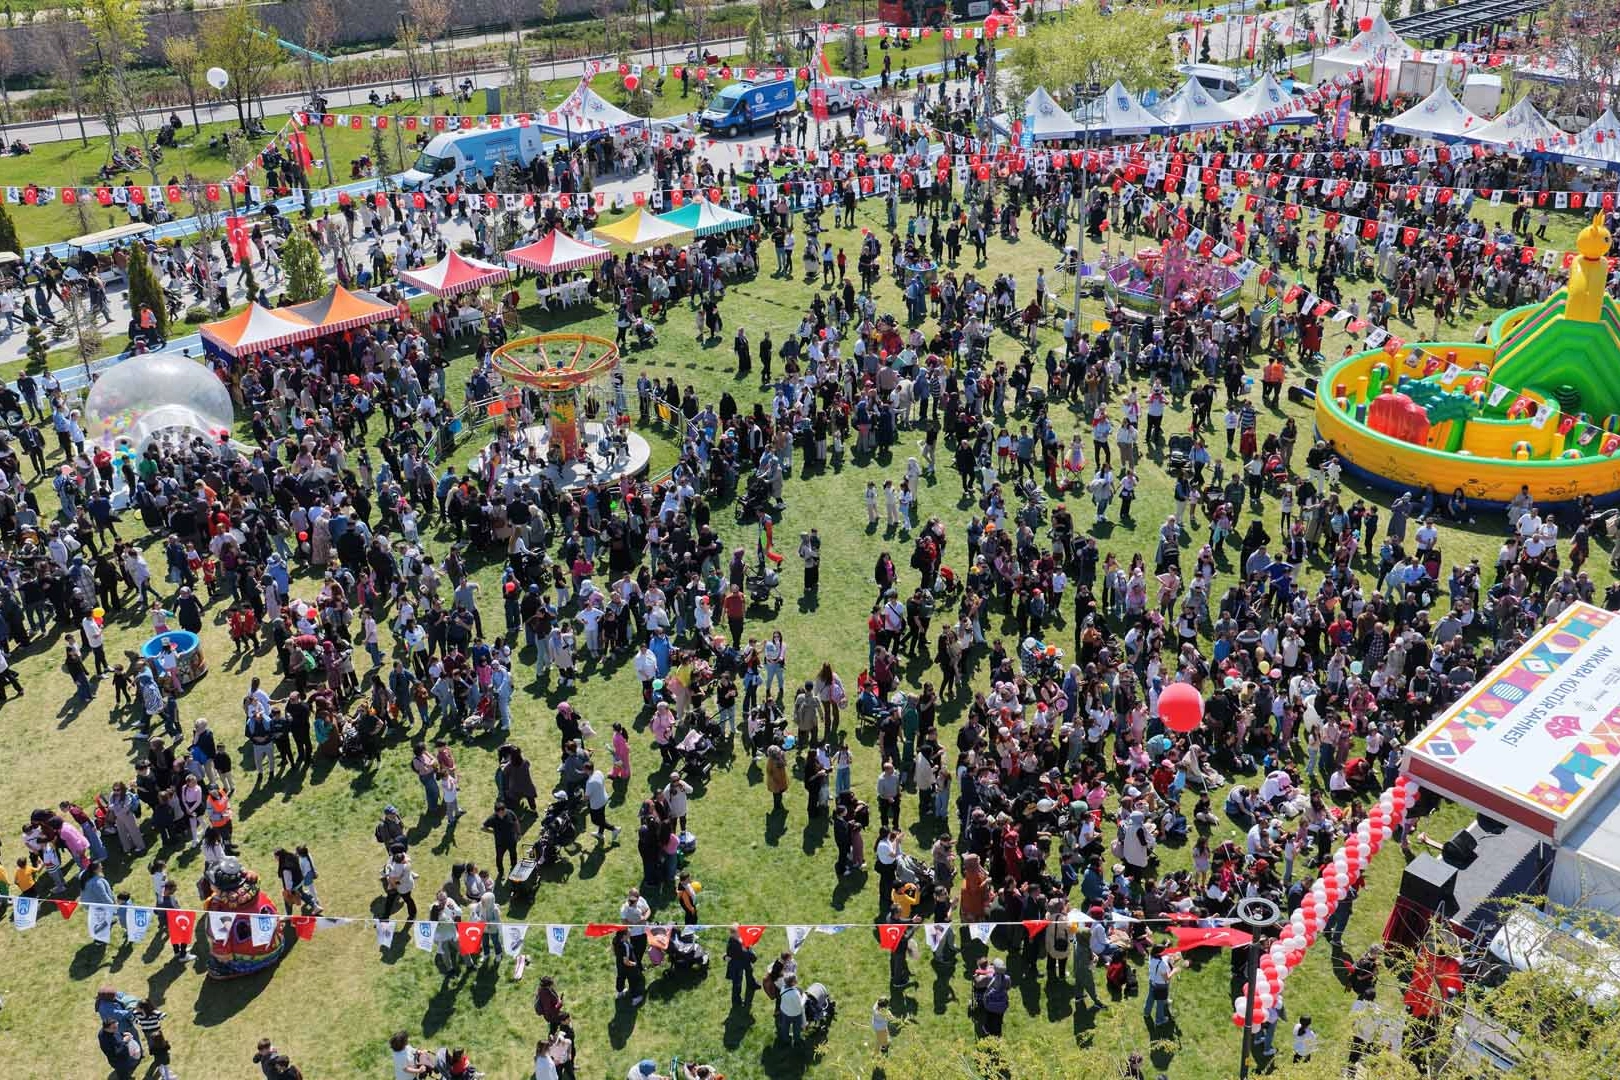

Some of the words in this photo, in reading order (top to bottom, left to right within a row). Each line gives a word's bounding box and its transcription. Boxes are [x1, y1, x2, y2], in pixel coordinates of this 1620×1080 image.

[1572, 646, 1613, 678] ANKARA
[1538, 678, 1580, 710] KÜLTÜR
[1500, 707, 1548, 748] SAHNESİ
